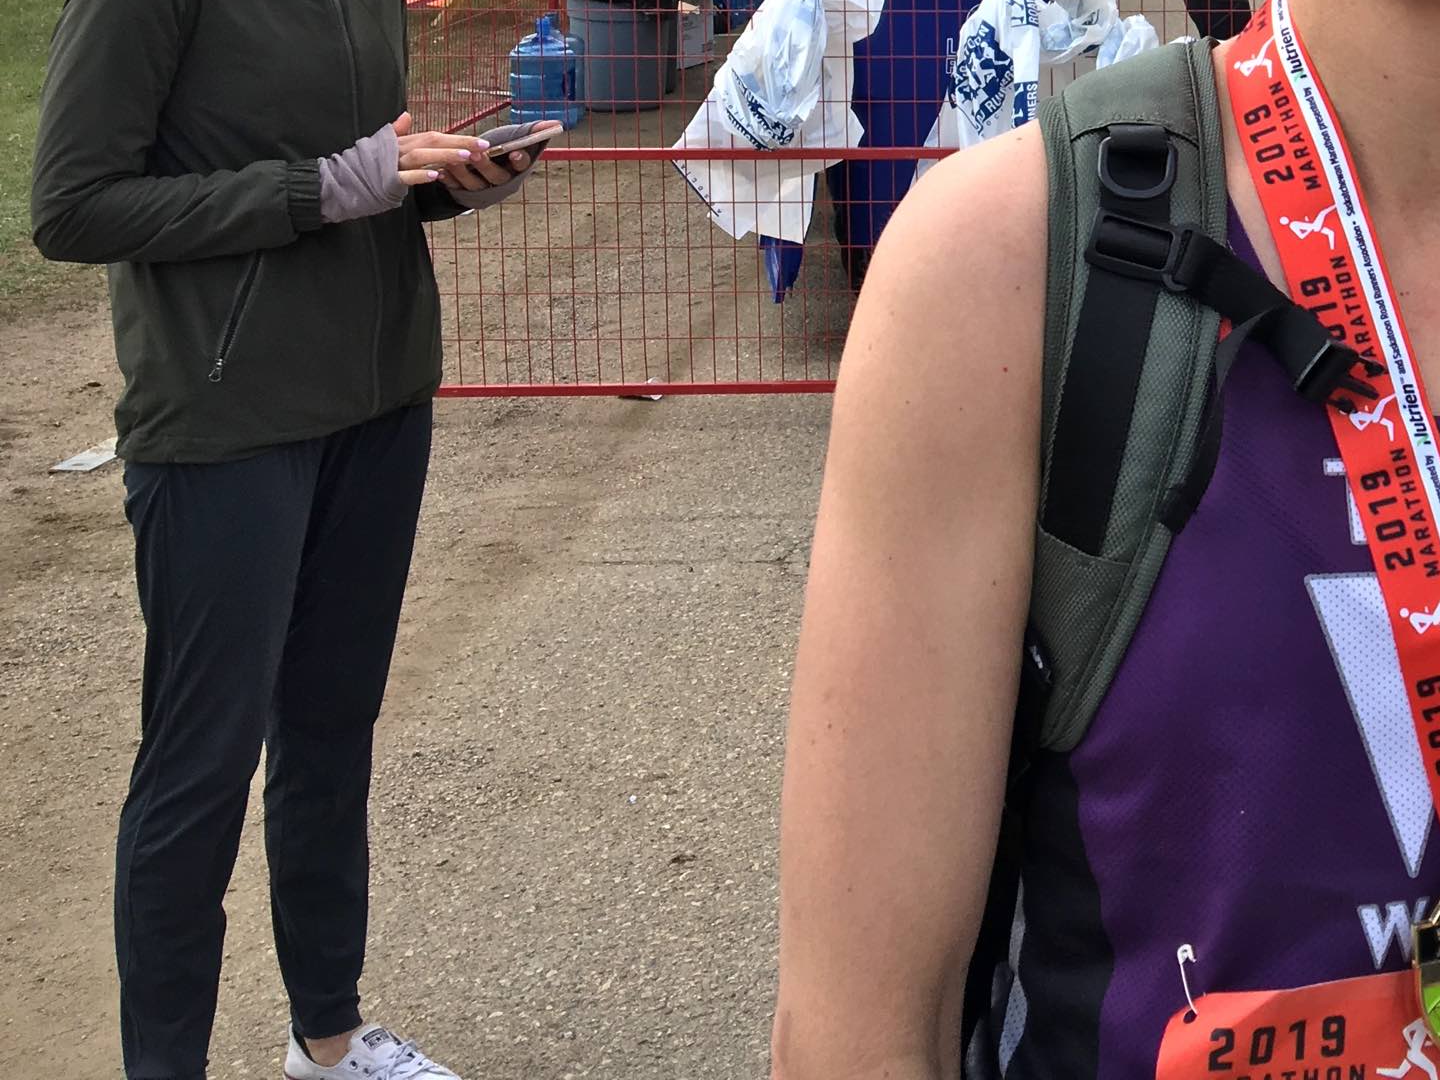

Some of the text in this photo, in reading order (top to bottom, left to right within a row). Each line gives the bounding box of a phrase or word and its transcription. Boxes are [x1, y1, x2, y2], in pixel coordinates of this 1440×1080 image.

[1280, 27, 1308, 82] Nutrien
[1027, 83, 1038, 121] NERS
[1303, 87, 1312, 97] by
[1306, 96, 1328, 131] presented
[1243, 104, 1295, 185] 2019
[1268, 80, 1322, 191] MARATHON
[1321, 130, 1339, 165] Marathon
[1334, 165, 1356, 217] Saskatchewan
[1300, 275, 1347, 342] 019
[1330, 255, 1377, 358] ARATHON
[1353, 225, 1406, 375] and Saskatoon Road Runners Association
[1402, 383, 1432, 447] Nutrien
[1425, 455, 1434, 466] by
[1360, 469, 1415, 572] 2019
[1207, 1015, 1346, 1071] 2019
